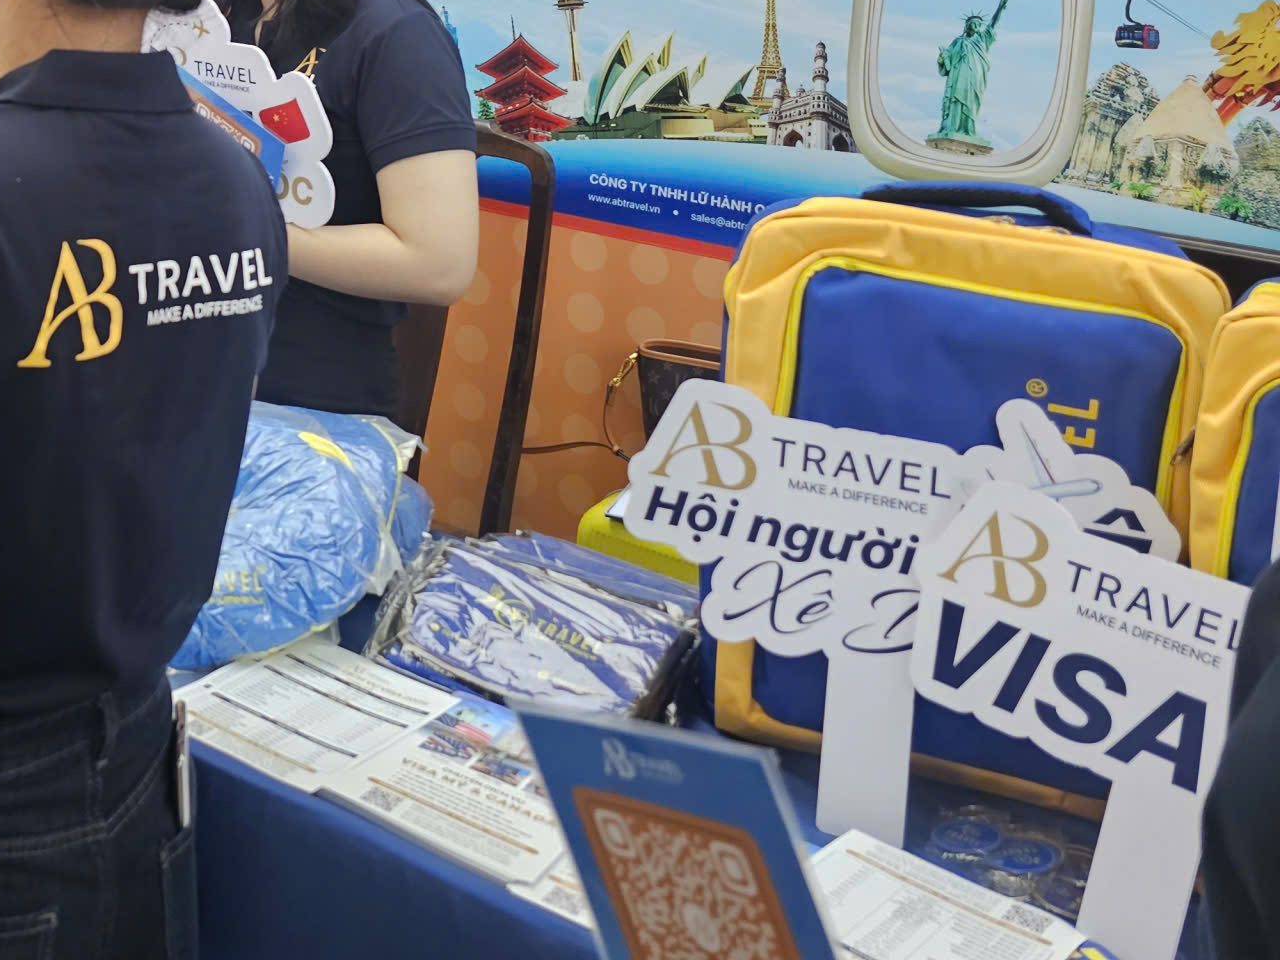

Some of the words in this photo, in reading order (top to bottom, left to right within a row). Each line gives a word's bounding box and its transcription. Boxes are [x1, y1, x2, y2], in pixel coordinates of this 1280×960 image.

[193, 59, 257, 85] TRAVEL
[587, 193, 661, 215] www.abtravel.vn
[589, 172, 628, 191] CÔNG
[629, 180, 648, 194] TY
[649, 183, 688, 202] TNHH
[690, 190, 710, 206] LỮ
[710, 194, 753, 214] HÀNH
[16, 237, 124, 369] AB
[127, 247, 274, 305] TRAVEL
[147, 304, 183, 327] MAKE
[181, 302, 194, 320] A
[194, 294, 264, 320] DIFFERENCE
[647, 399, 757, 492] AB
[770, 436, 952, 501] TRAVEL
[643, 485, 740, 543] Hội
[746, 514, 920, 576] người
[786, 477, 827, 497] MAKE
[830, 486, 841, 499] A
[841, 488, 928, 517] DIFFERENCE
[722, 560, 835, 635] Xê
[936, 509, 1050, 610] AB
[1066, 559, 1241, 653] TRAVEL
[1075, 604, 1120, 631] MAKE
[1119, 621, 1131, 635] A
[1130, 623, 1222, 670] DIFFERENCE
[932, 598, 1208, 794] VISA
